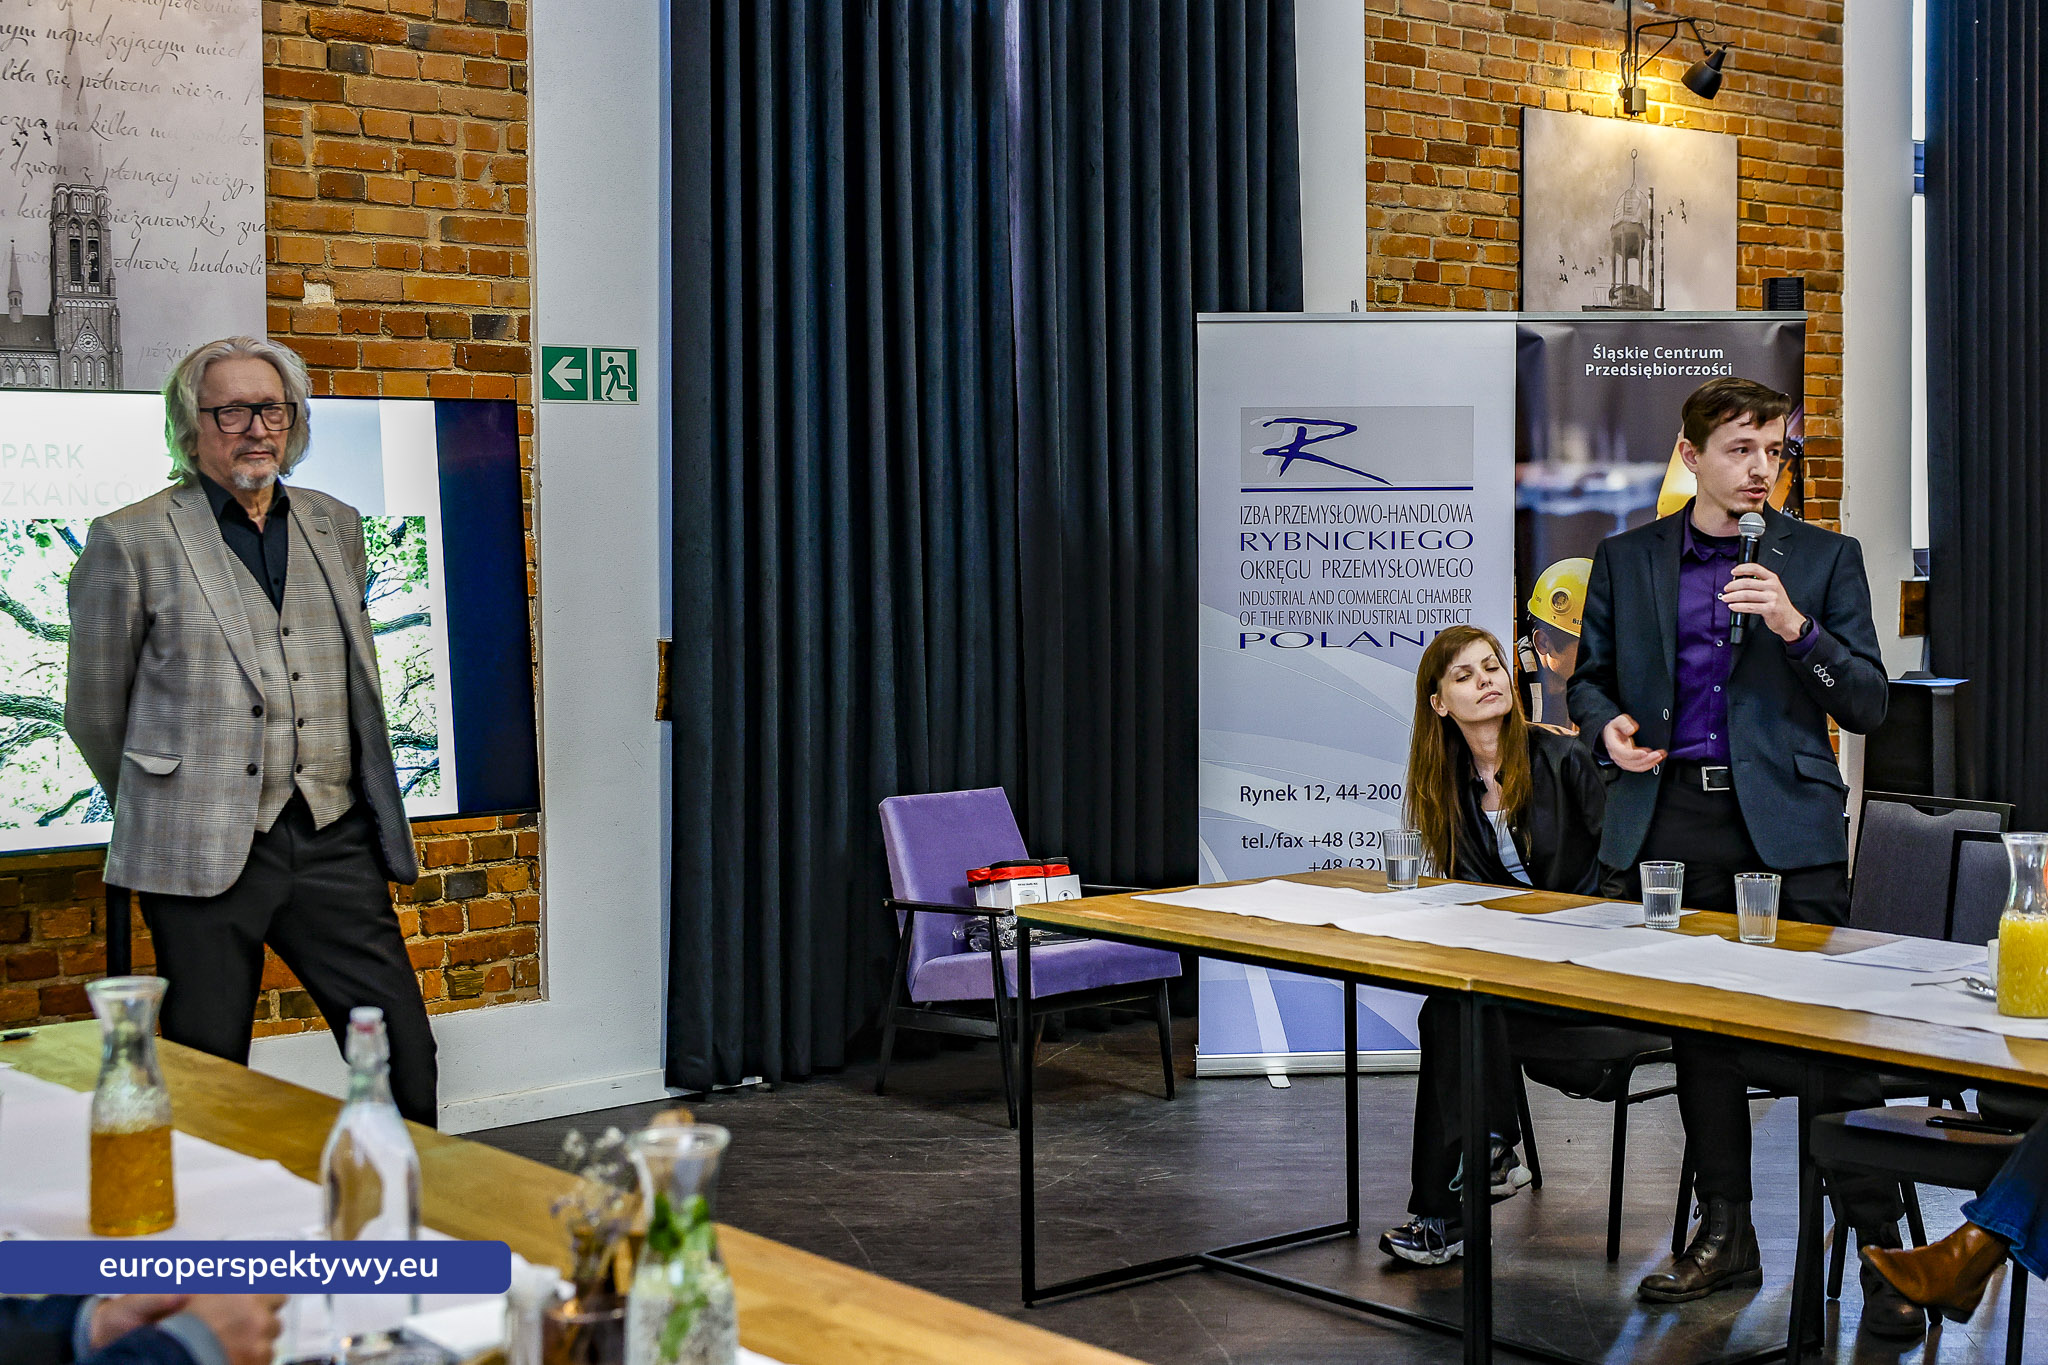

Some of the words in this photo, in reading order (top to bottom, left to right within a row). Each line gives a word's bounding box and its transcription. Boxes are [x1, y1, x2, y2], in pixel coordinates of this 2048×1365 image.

[46, 14, 186, 67] napędzającym
[46, 68, 71, 89] się
[78, 67, 161, 101] północna
[172, 81, 232, 106] wieża.
[86, 104, 140, 141] kilka
[10, 141, 68, 188] dzwon
[101, 156, 181, 198] płonącej
[191, 170, 255, 201] wieży,
[113, 238, 180, 274] odnowę
[1592, 343, 1649, 361] Śląskie
[1653, 346, 1724, 360] Centrum
[1585, 362, 1733, 379] Przedsiębiorczości
[2, 443, 86, 469] PARK
[1240, 505, 1272, 525] IZBA
[1274, 503, 1474, 525] PRZEMYSŁOWO-HANDLOWA
[1240, 529, 1474, 551] RYBNICKIEGO
[1240, 558, 1311, 584] OKRĘGU
[1322, 557, 1474, 579] PRZEMYSŁOWEGO
[1239, 590, 1306, 606] INDUSTRIAL
[1309, 589, 1334, 605] AND
[1337, 588, 1414, 605] COMMERCIAL
[1416, 588, 1472, 604] CHAMBER
[1239, 611, 1257, 627] OF
[1260, 610, 1285, 626] THE
[1288, 609, 1334, 626] RYBNIK
[1338, 608, 1413, 625] INDUSTRIAL
[1416, 608, 1472, 625] DISTRICT
[1239, 630, 1441, 650] POLAN
[1240, 784, 1298, 806] Rynek
[1304, 784, 1331, 804] 12,
[1336, 783, 1402, 801] 44-200
[1241, 831, 1304, 850] tel./fax
[1308, 831, 1344, 848] +48
[1348, 830, 1383, 850] (32)
